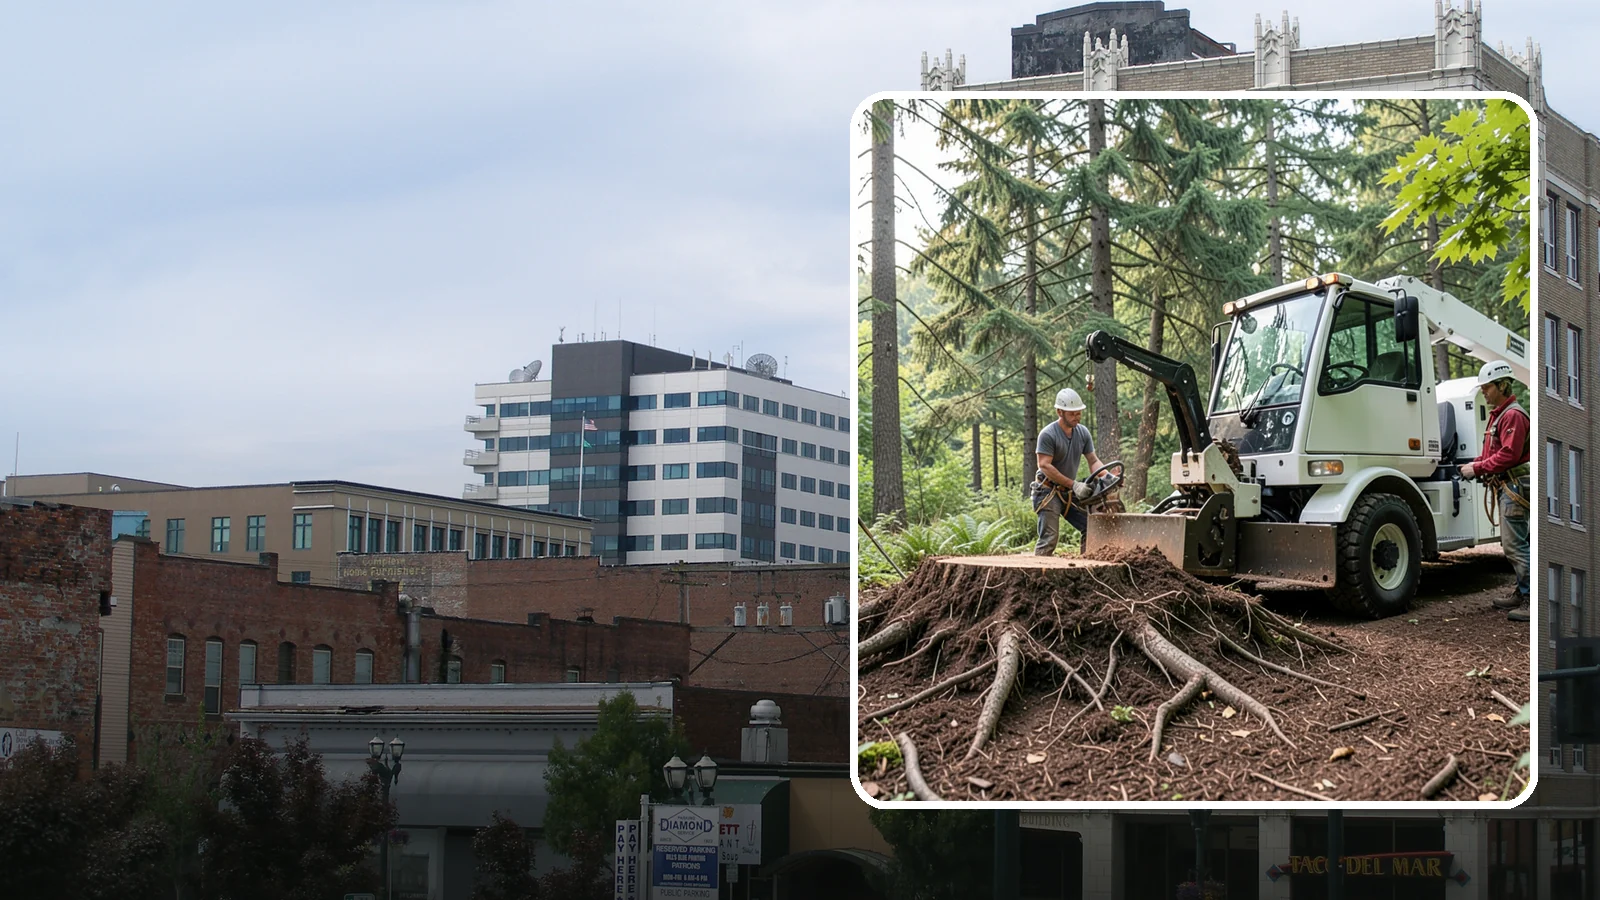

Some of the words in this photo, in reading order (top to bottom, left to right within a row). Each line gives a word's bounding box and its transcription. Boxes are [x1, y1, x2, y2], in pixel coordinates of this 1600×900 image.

[660, 818, 713, 832] DIAMOND
[1021, 815, 1070, 828] BUILDING
[617, 825, 625, 853] PAY
[628, 824, 637, 853] PAY
[656, 845, 688, 853] RESERVED
[689, 846, 716, 854] PARKING
[721, 851, 739, 862] Soup
[616, 856, 625, 893] HERE
[627, 855, 636, 893] HERE
[1345, 856, 1385, 876] DEL
[1392, 857, 1442, 877] MAR
[660, 888, 682, 897] PUBLIC
[683, 889, 710, 898] PARKING
